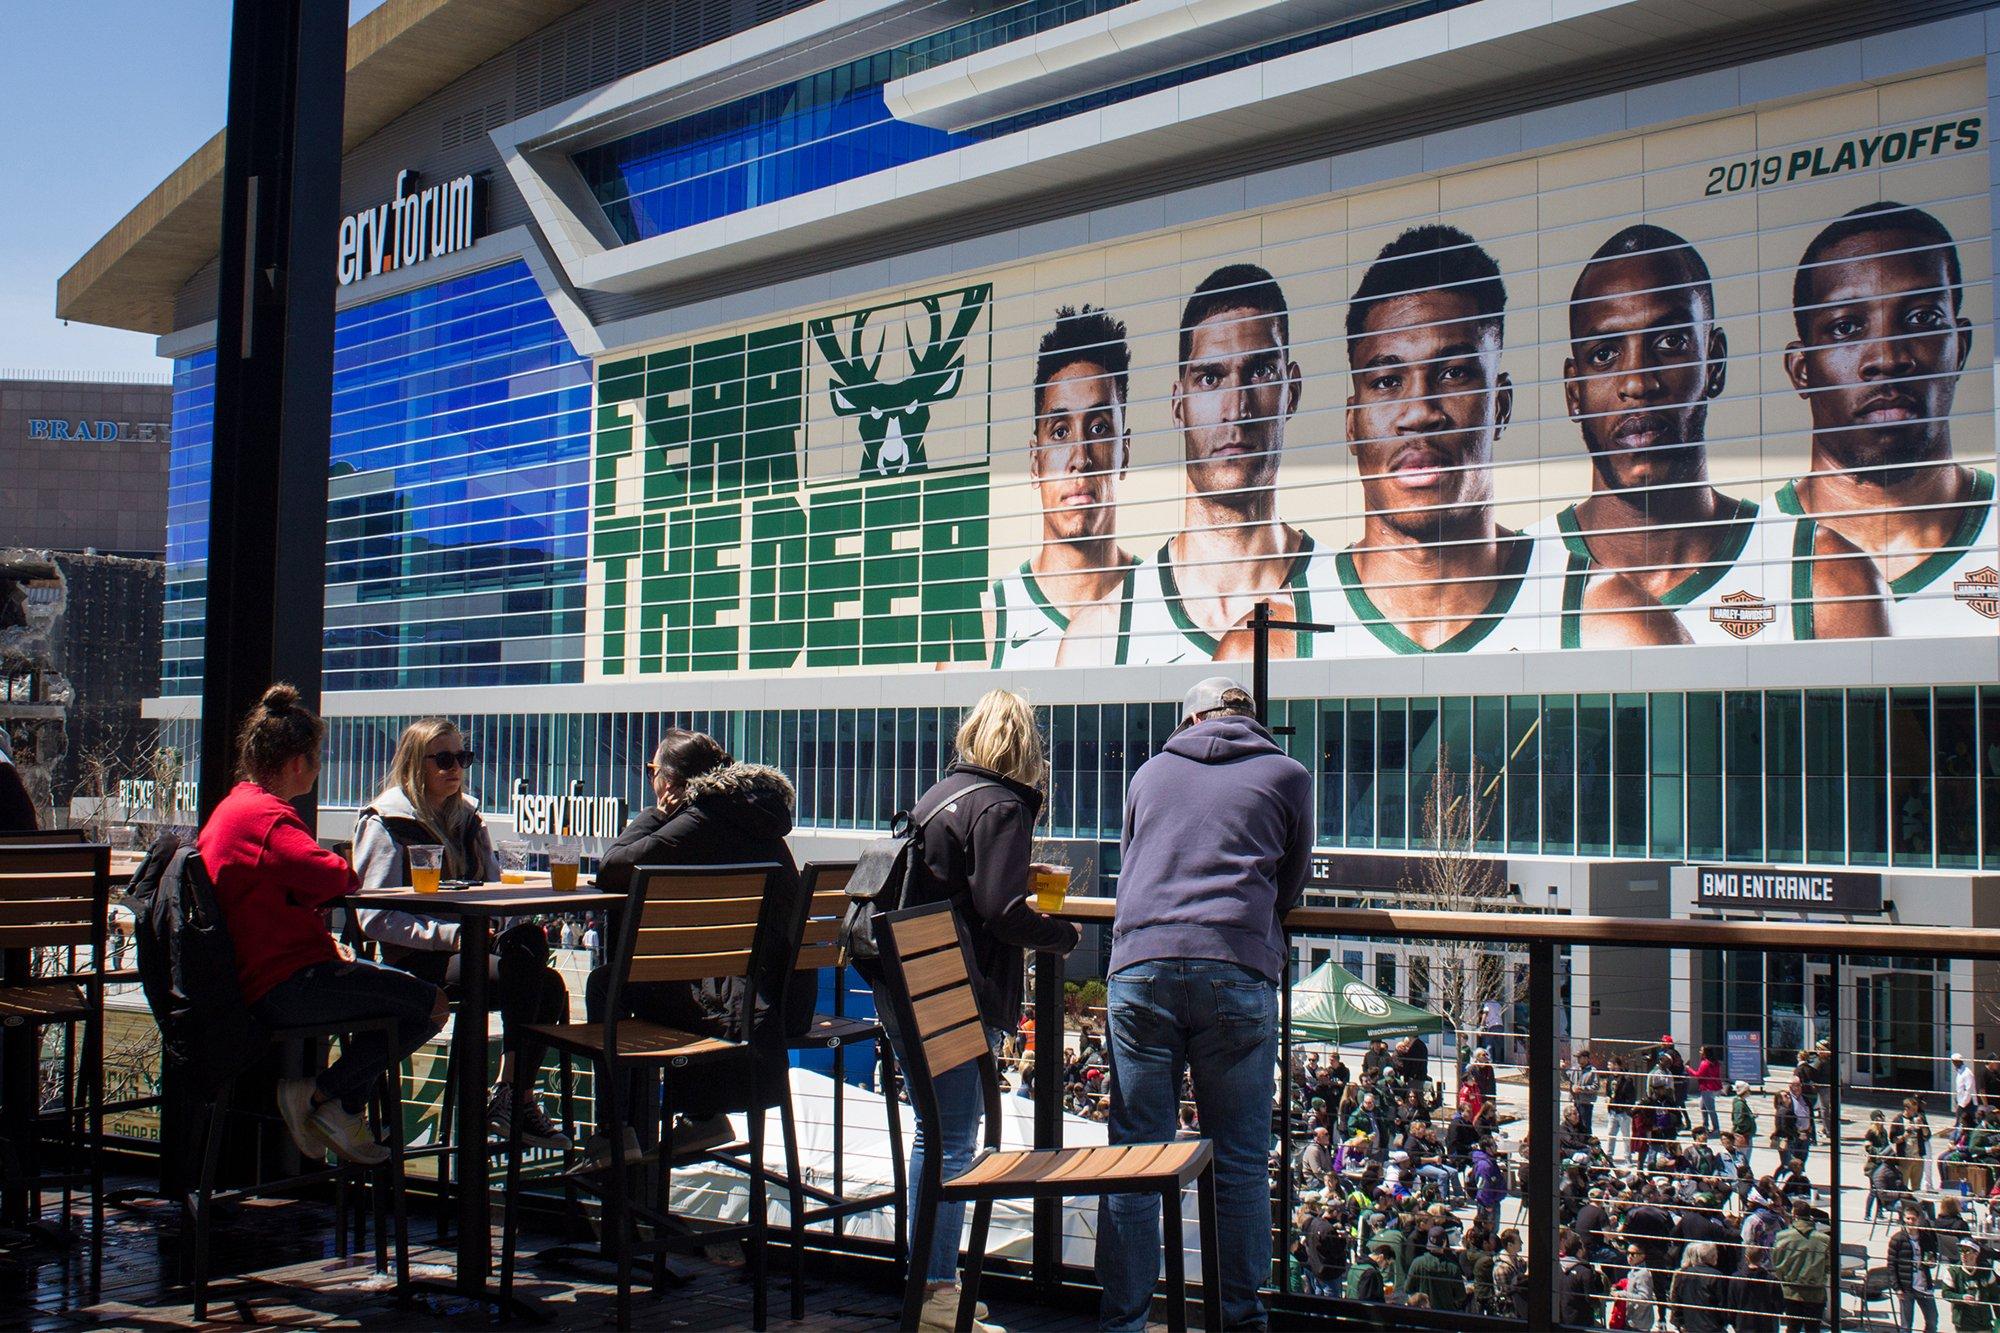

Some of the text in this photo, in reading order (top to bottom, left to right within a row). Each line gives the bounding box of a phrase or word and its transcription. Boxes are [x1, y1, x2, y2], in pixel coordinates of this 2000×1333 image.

[1705, 117, 1982, 197] 2019 PLAYOFFS
[594, 321, 803, 520] FEAR
[593, 472, 991, 675] THE DEER
[1726, 622, 1759, 636] CYCLES
[1703, 873, 1834, 901] BMO ENTRANCE
